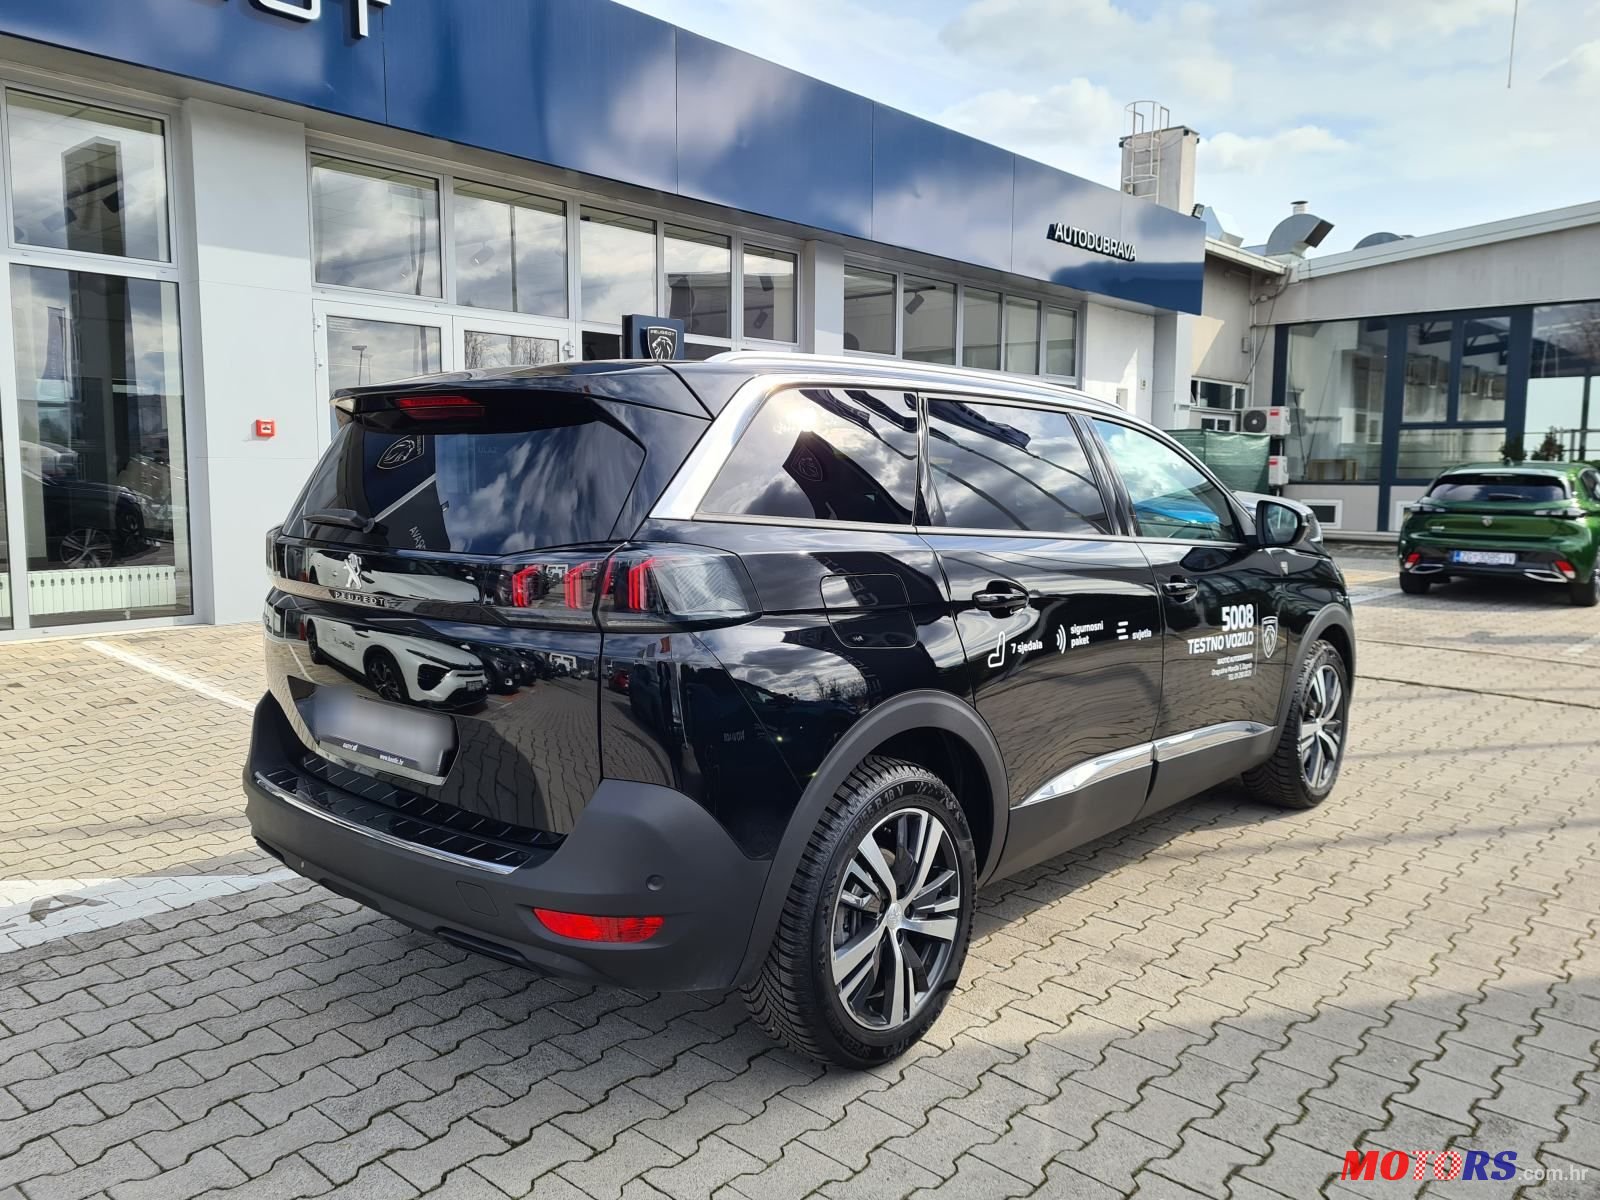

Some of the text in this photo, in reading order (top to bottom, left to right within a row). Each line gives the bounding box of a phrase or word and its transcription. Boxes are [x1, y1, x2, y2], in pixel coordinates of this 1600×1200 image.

[1054, 222, 1137, 261] AUTODUBRAVA
[650, 329, 675, 337] PEUGEOT
[1222, 603, 1254, 632] 5008
[1011, 640, 1043, 655] 7 sjedala
[1071, 635, 1089, 648] paket
[1187, 630, 1254, 655] TESTNO VOZILO
